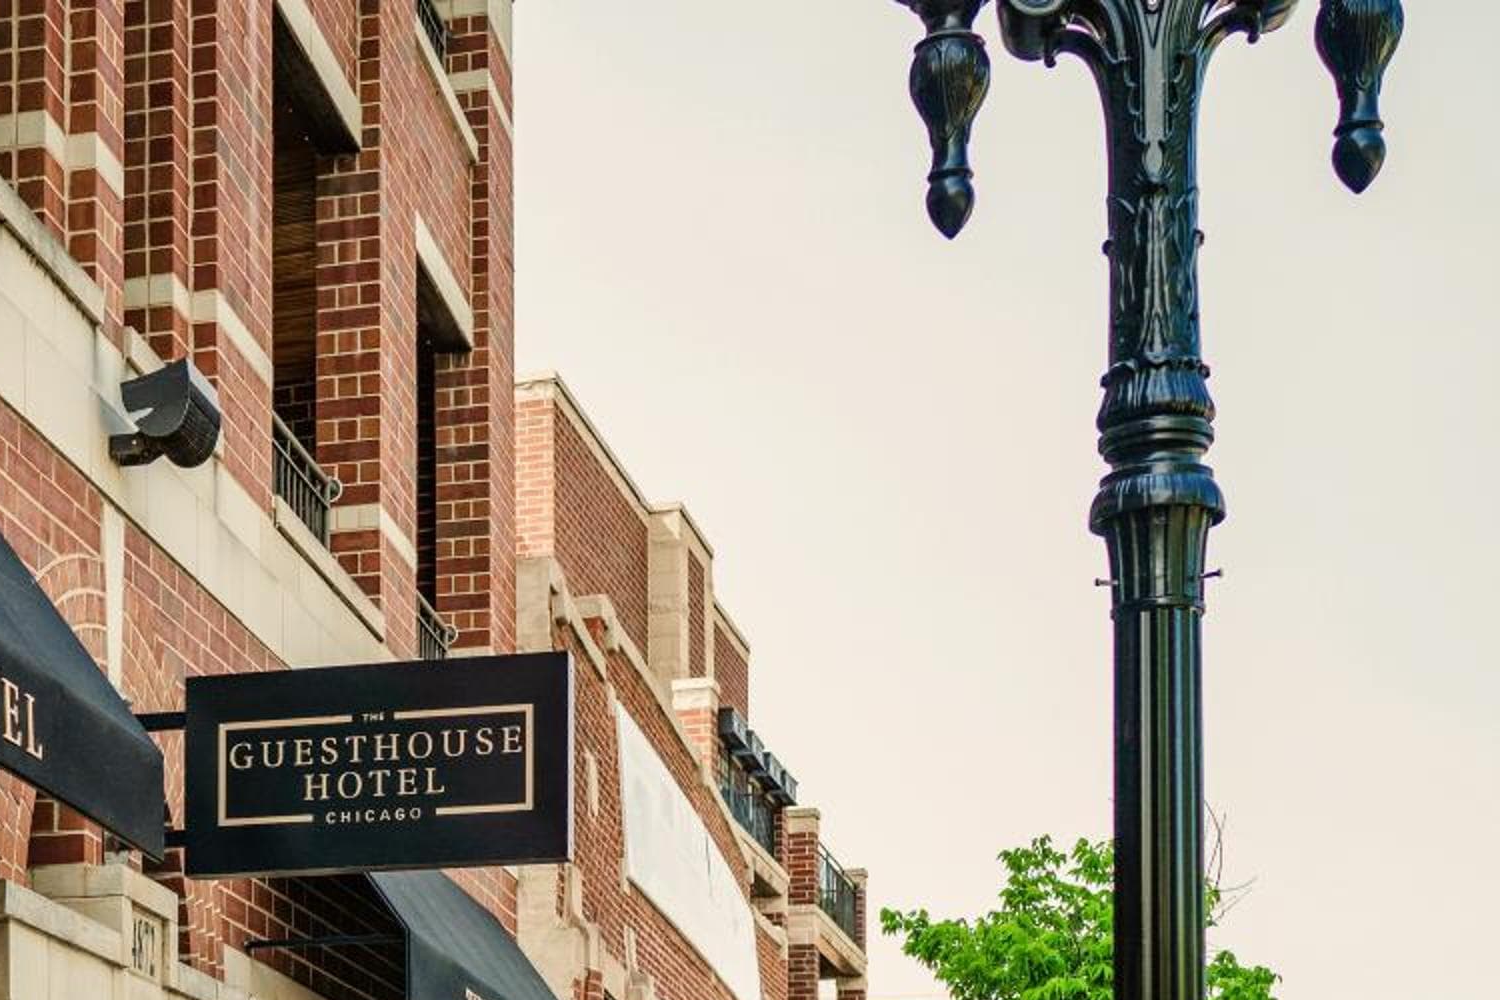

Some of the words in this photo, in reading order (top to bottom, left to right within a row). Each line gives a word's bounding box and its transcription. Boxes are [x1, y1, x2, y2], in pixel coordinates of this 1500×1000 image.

[363, 713, 385, 722] THE
[229, 726, 523, 770] GUESTHOUSE
[303, 767, 445, 801] HOTEL
[325, 807, 422, 825] CHICAGO
